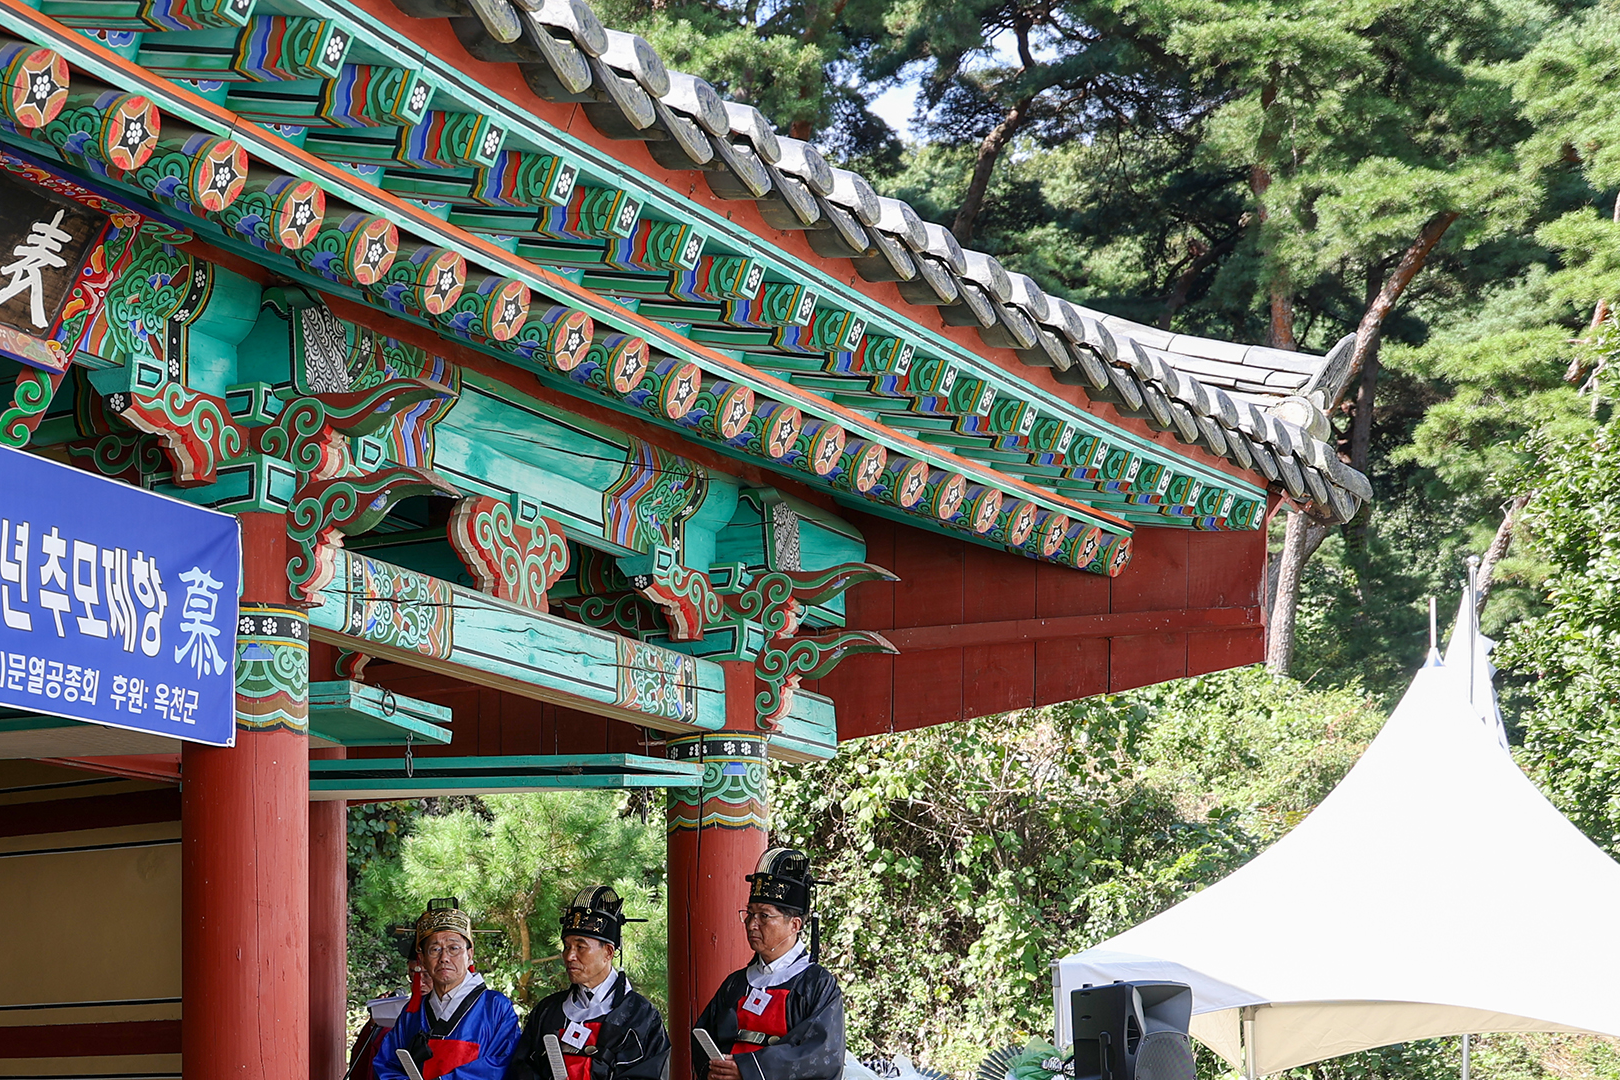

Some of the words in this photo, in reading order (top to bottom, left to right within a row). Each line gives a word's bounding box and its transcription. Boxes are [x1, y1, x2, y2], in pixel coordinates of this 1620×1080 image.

[39, 526, 168, 657] 추모제향
[174, 566, 228, 680] 慕
[110, 674, 149, 714] 후원:
[154, 683, 199, 725] 옥천군
